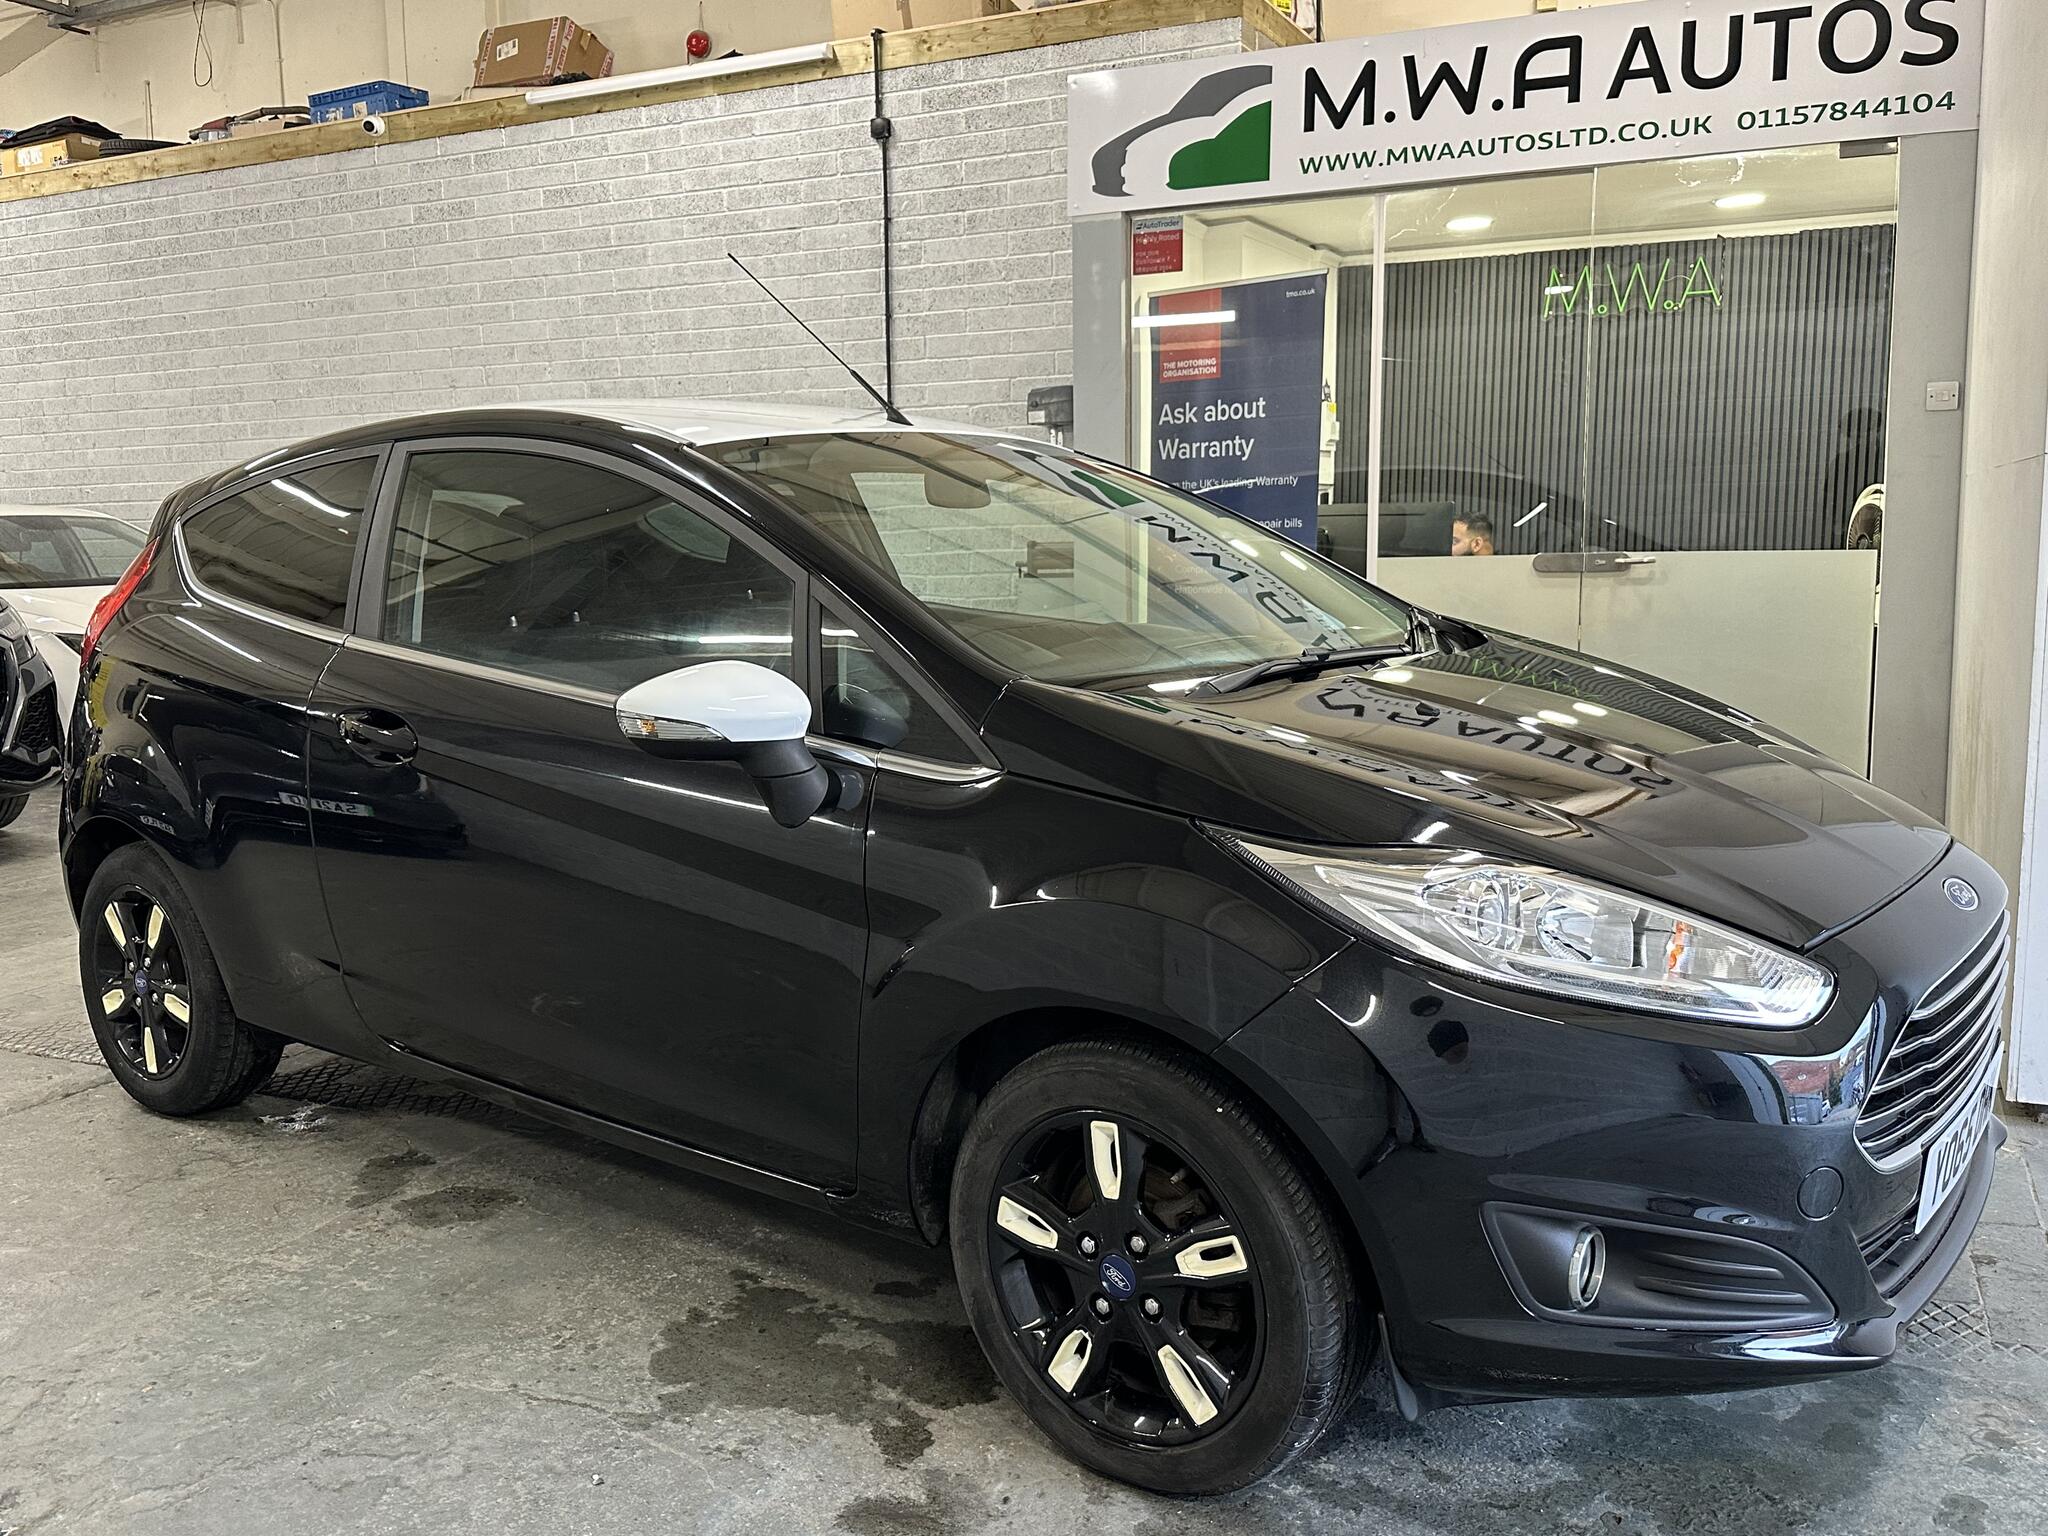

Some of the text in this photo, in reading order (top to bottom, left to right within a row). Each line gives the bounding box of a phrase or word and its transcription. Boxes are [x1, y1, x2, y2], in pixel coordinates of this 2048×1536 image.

[1303, 0, 1960, 133] M.W.A AUTOS
[1299, 91, 1956, 175] WWW.MWAAUTOSLTD.CO.UK 01157844104
[1142, 220, 1180, 229] AutoTrader
[1543, 256, 1722, 318] M.W.A
[1163, 357, 1217, 370] THE MOTORING
[1163, 366, 1217, 378] ORGANISATION
[1158, 397, 1266, 426] Ask about
[1158, 435, 1255, 461] Warranty
[1181, 475, 1299, 489] the UK's leading Warranty
[1259, 518, 1303, 529] epair bills
[1106, 1268, 1126, 1288] Ford
